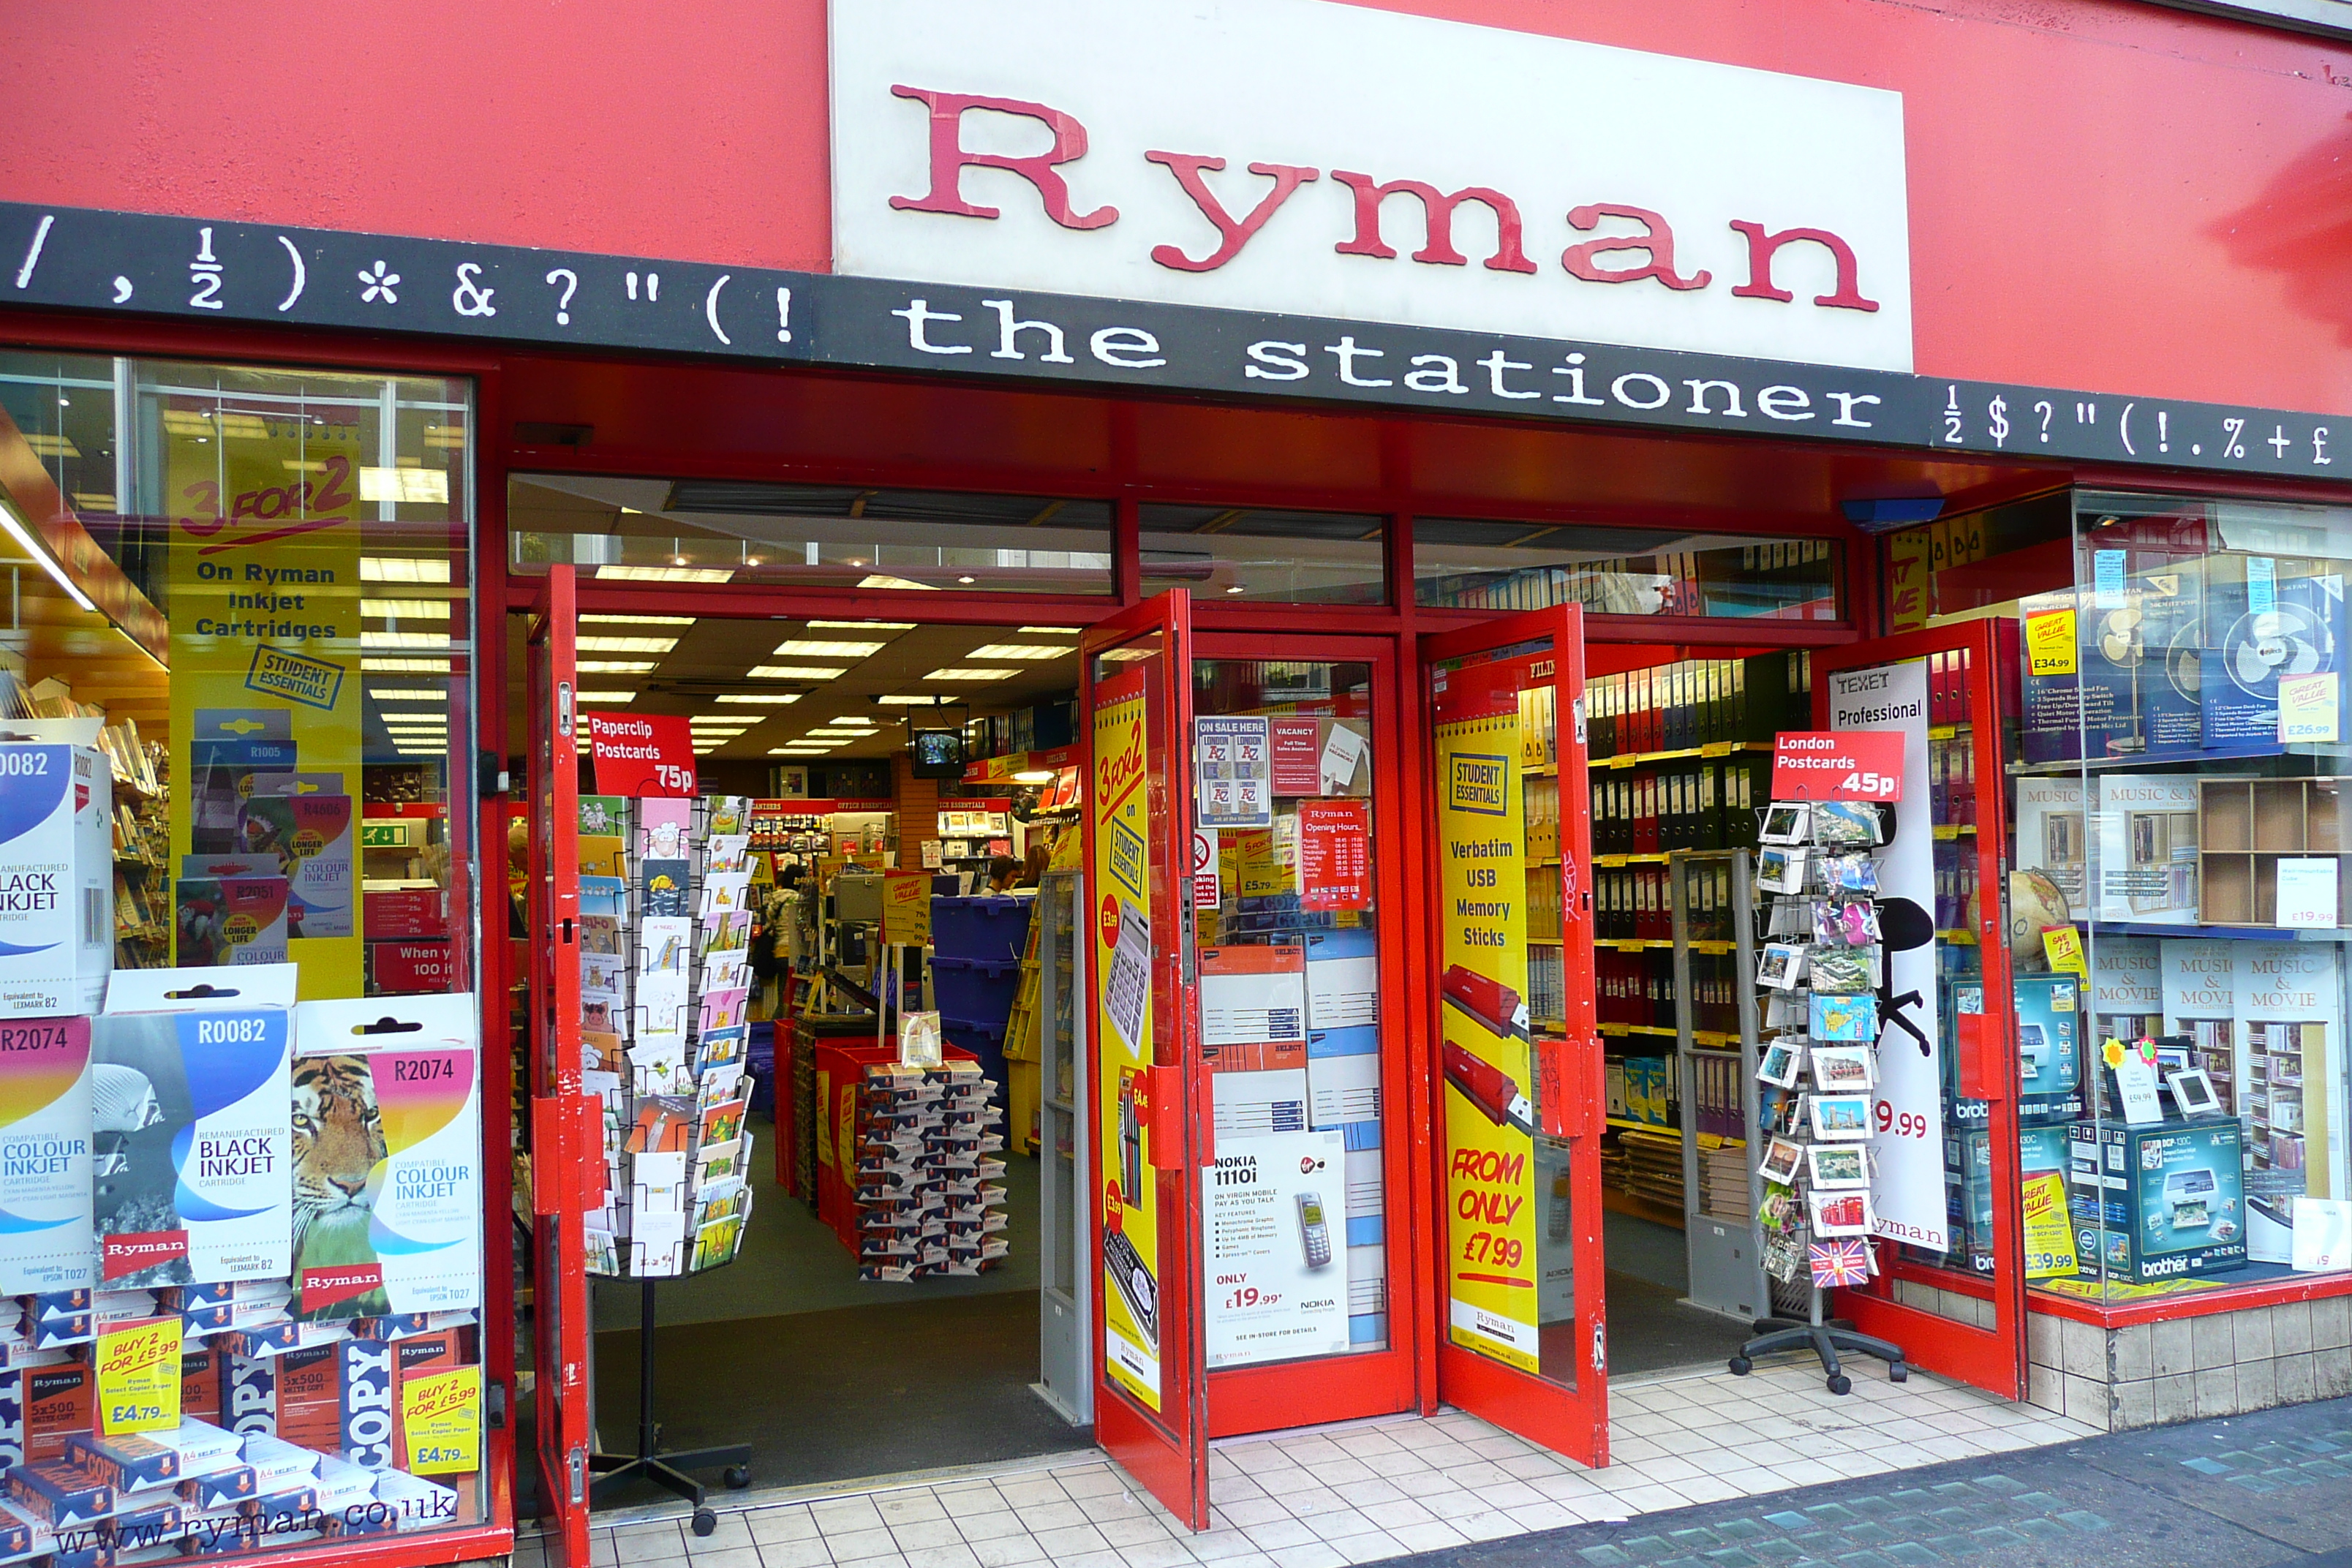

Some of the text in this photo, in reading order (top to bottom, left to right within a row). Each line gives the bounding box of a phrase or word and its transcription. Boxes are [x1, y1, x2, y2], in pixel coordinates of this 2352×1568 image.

[889, 84, 1880, 313] Ryman
[453, 263, 577, 325] & ?
[891, 298, 1882, 429] the stationer
[1989, 395, 2331, 464] $ ? % £
[180, 455, 352, 536] 3 FOR 2
[197, 562, 334, 585] On Ryman
[229, 592, 304, 614] Inkjet
[196, 619, 336, 641] Cartridges
[2035, 617, 2064, 631] GREAT
[2038, 624, 2067, 640] VALUE
[264, 655, 332, 685] STUDENT
[2035, 658, 2069, 668] £34.99
[259, 671, 326, 700] ESSENTIALS
[1837, 672, 1889, 694] TEXET
[2288, 680, 2325, 696] GREAT
[2291, 688, 2327, 704] VALUE
[1839, 699, 1921, 727] Professional
[592, 718, 652, 739] Paperclip
[1200, 723, 1264, 732] ON SALE HERE
[2288, 725, 2329, 735] £26.99
[1204, 736, 1229, 745] LONDON
[1237, 736, 1262, 745] LONDON
[1779, 737, 1834, 749] London
[251, 747, 280, 758] R1005
[595, 742, 660, 760] Postcards
[1099, 719, 1142, 806] 3 FOR 2
[1778, 755, 1855, 769] Postcards
[655, 765, 693, 793] 75p
[1456, 763, 1499, 785] STUDENT
[1843, 772, 1894, 796] 45p
[1456, 784, 1499, 804] ESSENTIALS
[2028, 791, 2078, 802] MUSIC
[2111, 788, 2185, 801] MUSIC &
[1126, 804, 1135, 817] on
[1311, 810, 1353, 818] Ryman
[1306, 823, 1335, 833] Opening
[292, 841, 323, 849] LONGER
[1115, 828, 1140, 861] STUDENT
[1451, 838, 1512, 859] Verbatim
[299, 848, 315, 856] LIFE
[304, 863, 349, 873] COLOUR
[304, 872, 341, 882] INKJET
[1466, 869, 1497, 887] USB
[893, 880, 920, 892] GREAT
[1245, 881, 1270, 891] £5.79
[894, 887, 921, 900] VALUE
[1457, 898, 1510, 921] Memory
[2292, 911, 2333, 921] £19.99
[1103, 910, 1117, 927] £3.99
[223, 926, 257, 935] LONGER
[1464, 927, 1505, 947] Sticks
[232, 934, 249, 943] LIFE
[2052, 932, 2068, 945] SAVE
[400, 947, 438, 958] When
[2059, 942, 2071, 954] £2
[237, 951, 284, 961] COLOUR
[414, 964, 439, 975] 100
[2098, 957, 2157, 970] MUSIC
[2250, 960, 2314, 973] MUSIC
[2122, 973, 2136, 985] &
[2276, 976, 2291, 990] &
[2099, 987, 2160, 1000] MOVIE
[2251, 992, 2317, 1007] MOVIE
[13, 998, 57, 1009] LEXMARK 82
[199, 1019, 265, 1044] R0082
[1, 1028, 68, 1052] R2074
[395, 1059, 454, 1081] R2074
[3, 1133, 59, 1143] COMPATIBLE
[199, 1128, 285, 1139] REMANUFACTURED
[4, 1140, 86, 1160] COLOUR
[200, 1138, 272, 1158] BLACK
[4, 1156, 72, 1176] INKJET
[200, 1156, 276, 1177] INKJET
[395, 1158, 445, 1169] COMPATIBLE
[1215, 1156, 1256, 1169] NOKIA
[1452, 1149, 1525, 1186] FROM
[3, 1176, 50, 1186] CARTRIDGE
[199, 1177, 246, 1188] CARTRIDGE
[396, 1166, 469, 1186] COLOUR
[1215, 1168, 1256, 1186] 1110i
[396, 1182, 456, 1199] INKJET
[1227, 1191, 1250, 1199] VIRGIN
[1107, 1199, 1121, 1216] £3.99
[1458, 1189, 1523, 1226] ONLY
[108, 1240, 186, 1256] Ryman
[230, 1259, 273, 1273] LEXMARK 82
[2141, 1258, 2188, 1278] brother
[43, 1268, 88, 1282] EPSON T027
[306, 1273, 379, 1289] Ryman
[1217, 1273, 1246, 1284] ONLY
[430, 1289, 470, 1301] EPSON T027
[235, 1303, 247, 1312] A4
[1301, 1299, 1335, 1308] NOKIA
[1477, 1311, 1515, 1333] Ryman
[1249, 1331, 1277, 1339] IN-STORE
[113, 1332, 159, 1357] BUY 2
[402, 1346, 444, 1355] Ryman
[101, 1341, 178, 1376] FOR £5.99
[1120, 1341, 1144, 1366] Ryman
[1215, 1351, 1251, 1360] Ryman
[34, 1376, 82, 1387] Ryman
[418, 1379, 459, 1402] BUY 2
[406, 1387, 476, 1420] FOR £5.99
[112, 1405, 160, 1422] £4.79
[184, 1449, 222, 1461] A4 SELECT
[418, 1447, 461, 1463] £4.79
[260, 1466, 298, 1478] A4 SELECT
[320, 1485, 357, 1499] A4 SELECT
[53, 1490, 456, 1555] www.ryman.co.uk
